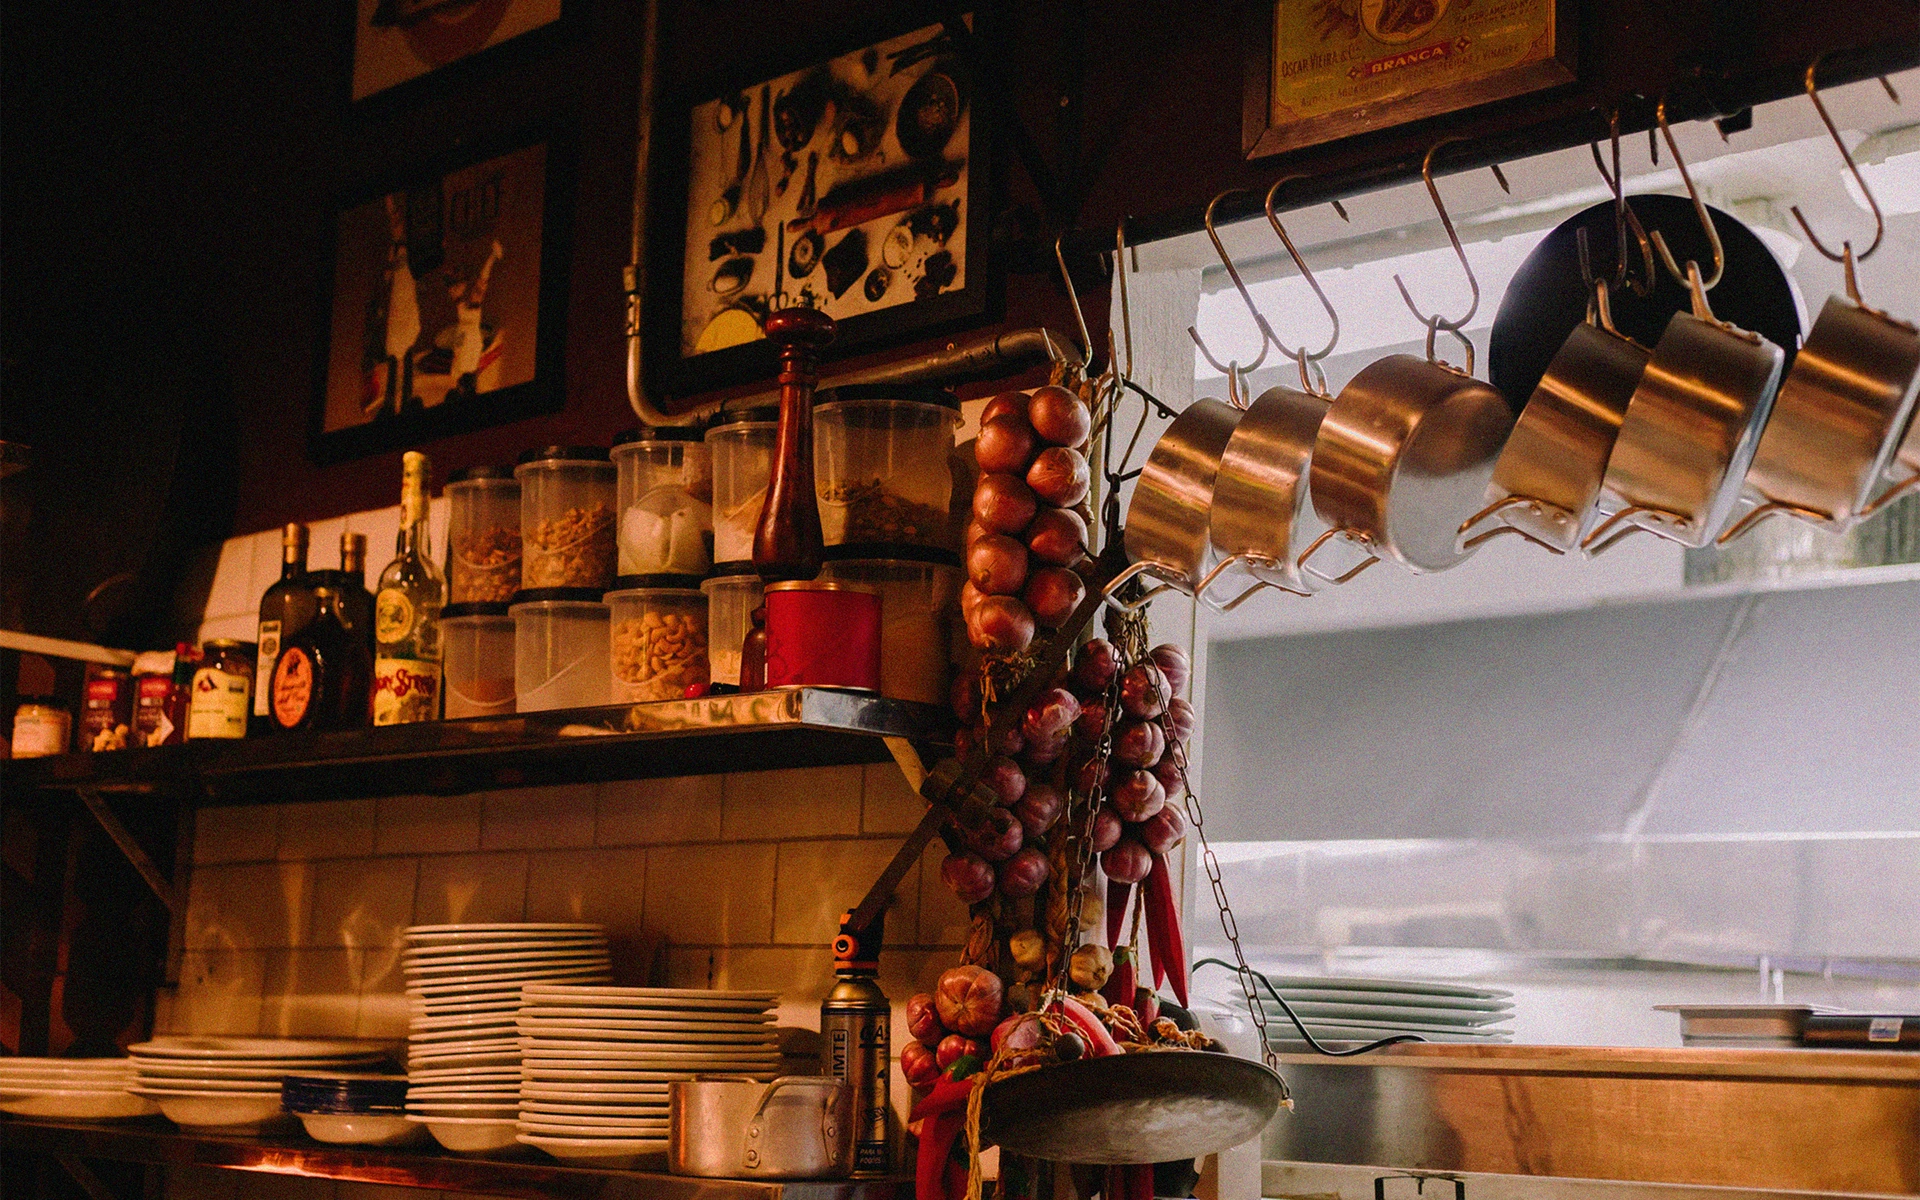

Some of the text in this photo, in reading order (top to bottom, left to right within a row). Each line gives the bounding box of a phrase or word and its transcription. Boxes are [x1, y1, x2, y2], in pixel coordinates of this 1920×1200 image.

[1282, 57, 1309, 77] OSCAR
[1372, 46, 1443, 74] BRANCA
[833, 1033, 845, 1081] IMTE
